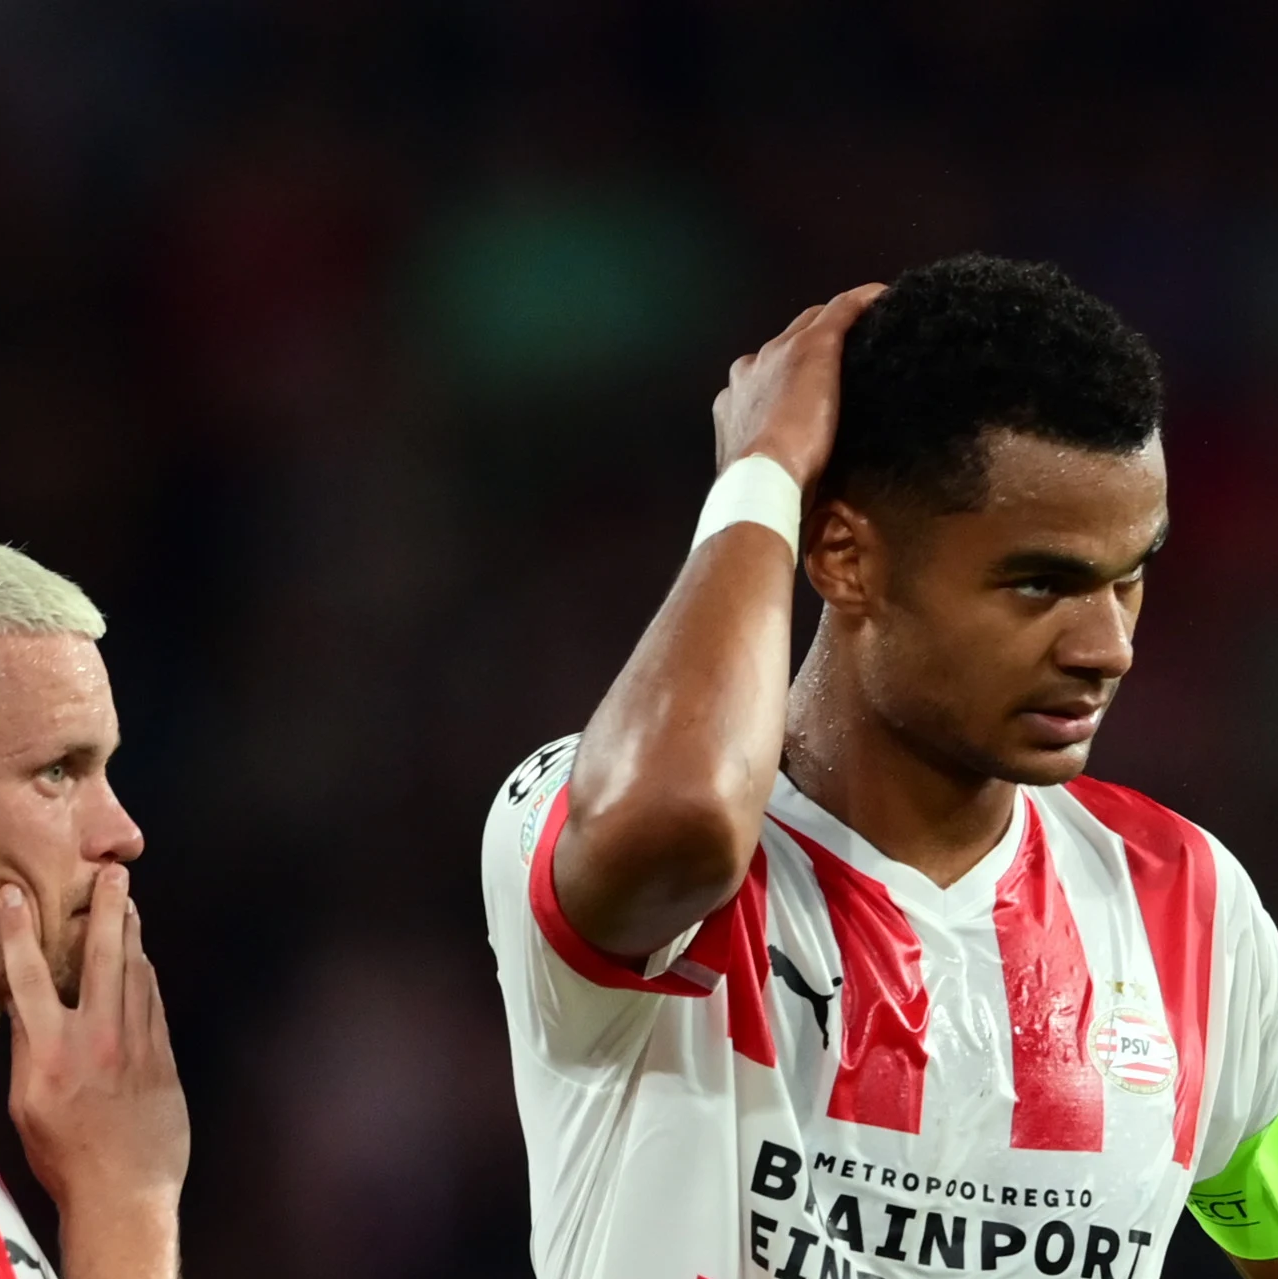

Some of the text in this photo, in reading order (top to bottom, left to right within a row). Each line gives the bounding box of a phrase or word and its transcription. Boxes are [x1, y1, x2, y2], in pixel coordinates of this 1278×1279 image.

[1120, 1036, 1150, 1057] PSV
[813, 1151, 1093, 1208] METROPOOLREGIO
[1190, 1199, 1247, 1220] ECT
